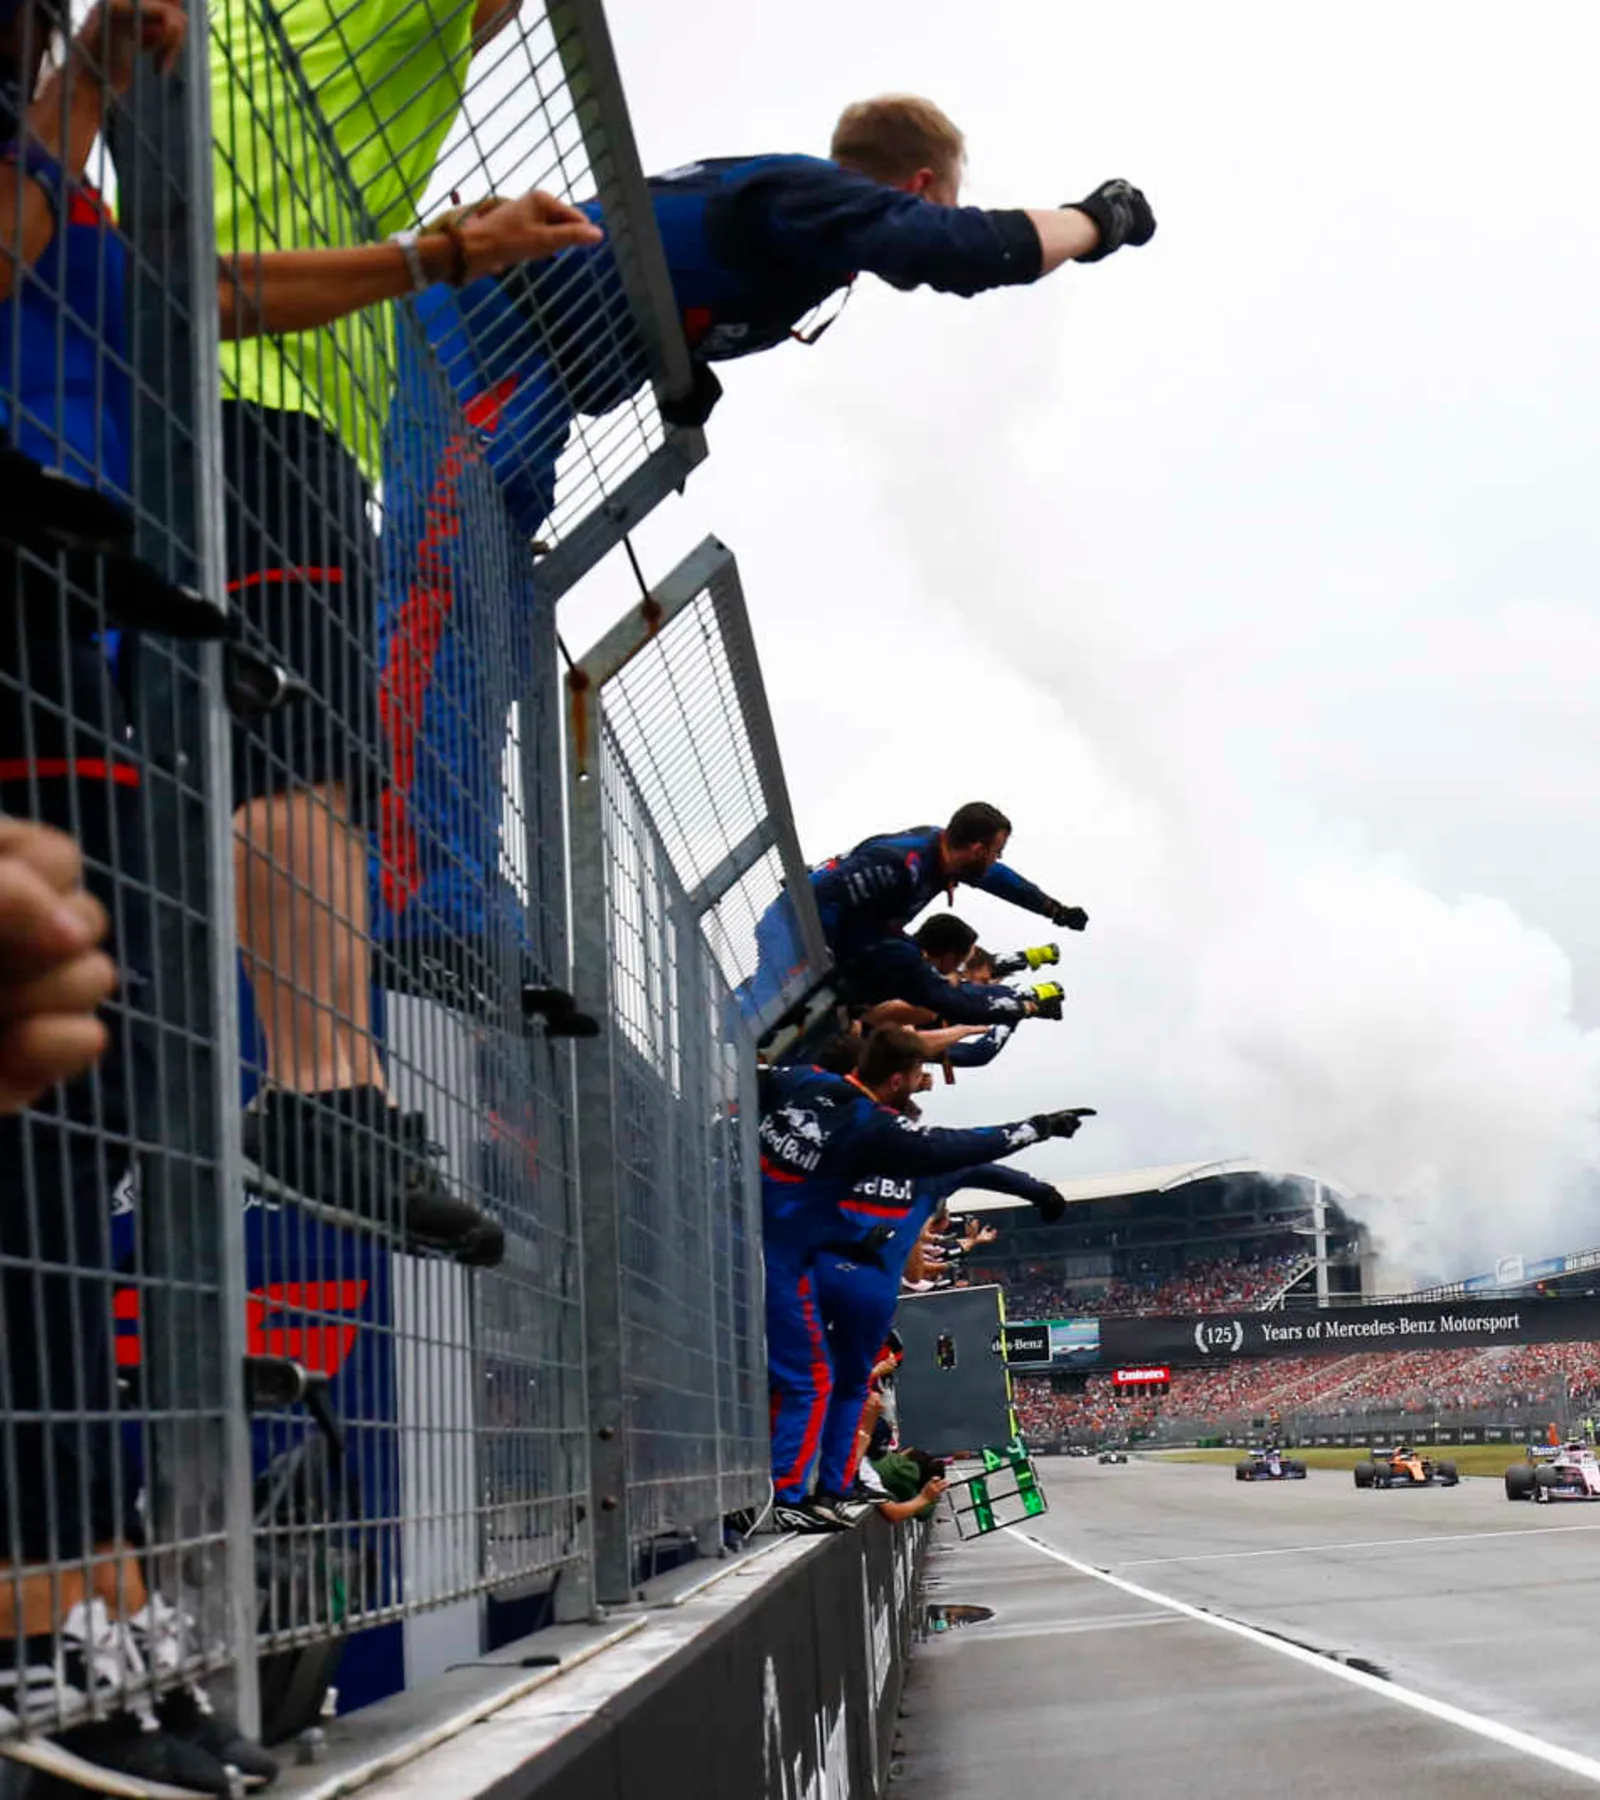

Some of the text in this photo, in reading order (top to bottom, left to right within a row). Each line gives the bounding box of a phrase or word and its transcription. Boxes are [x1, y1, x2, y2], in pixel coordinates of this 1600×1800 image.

[1205, 1326, 1232, 1344] 125
[1261, 1314, 1520, 1341] Years of Mercedes-Benz Motorsport
[1117, 1370, 1165, 1381] Emirates
